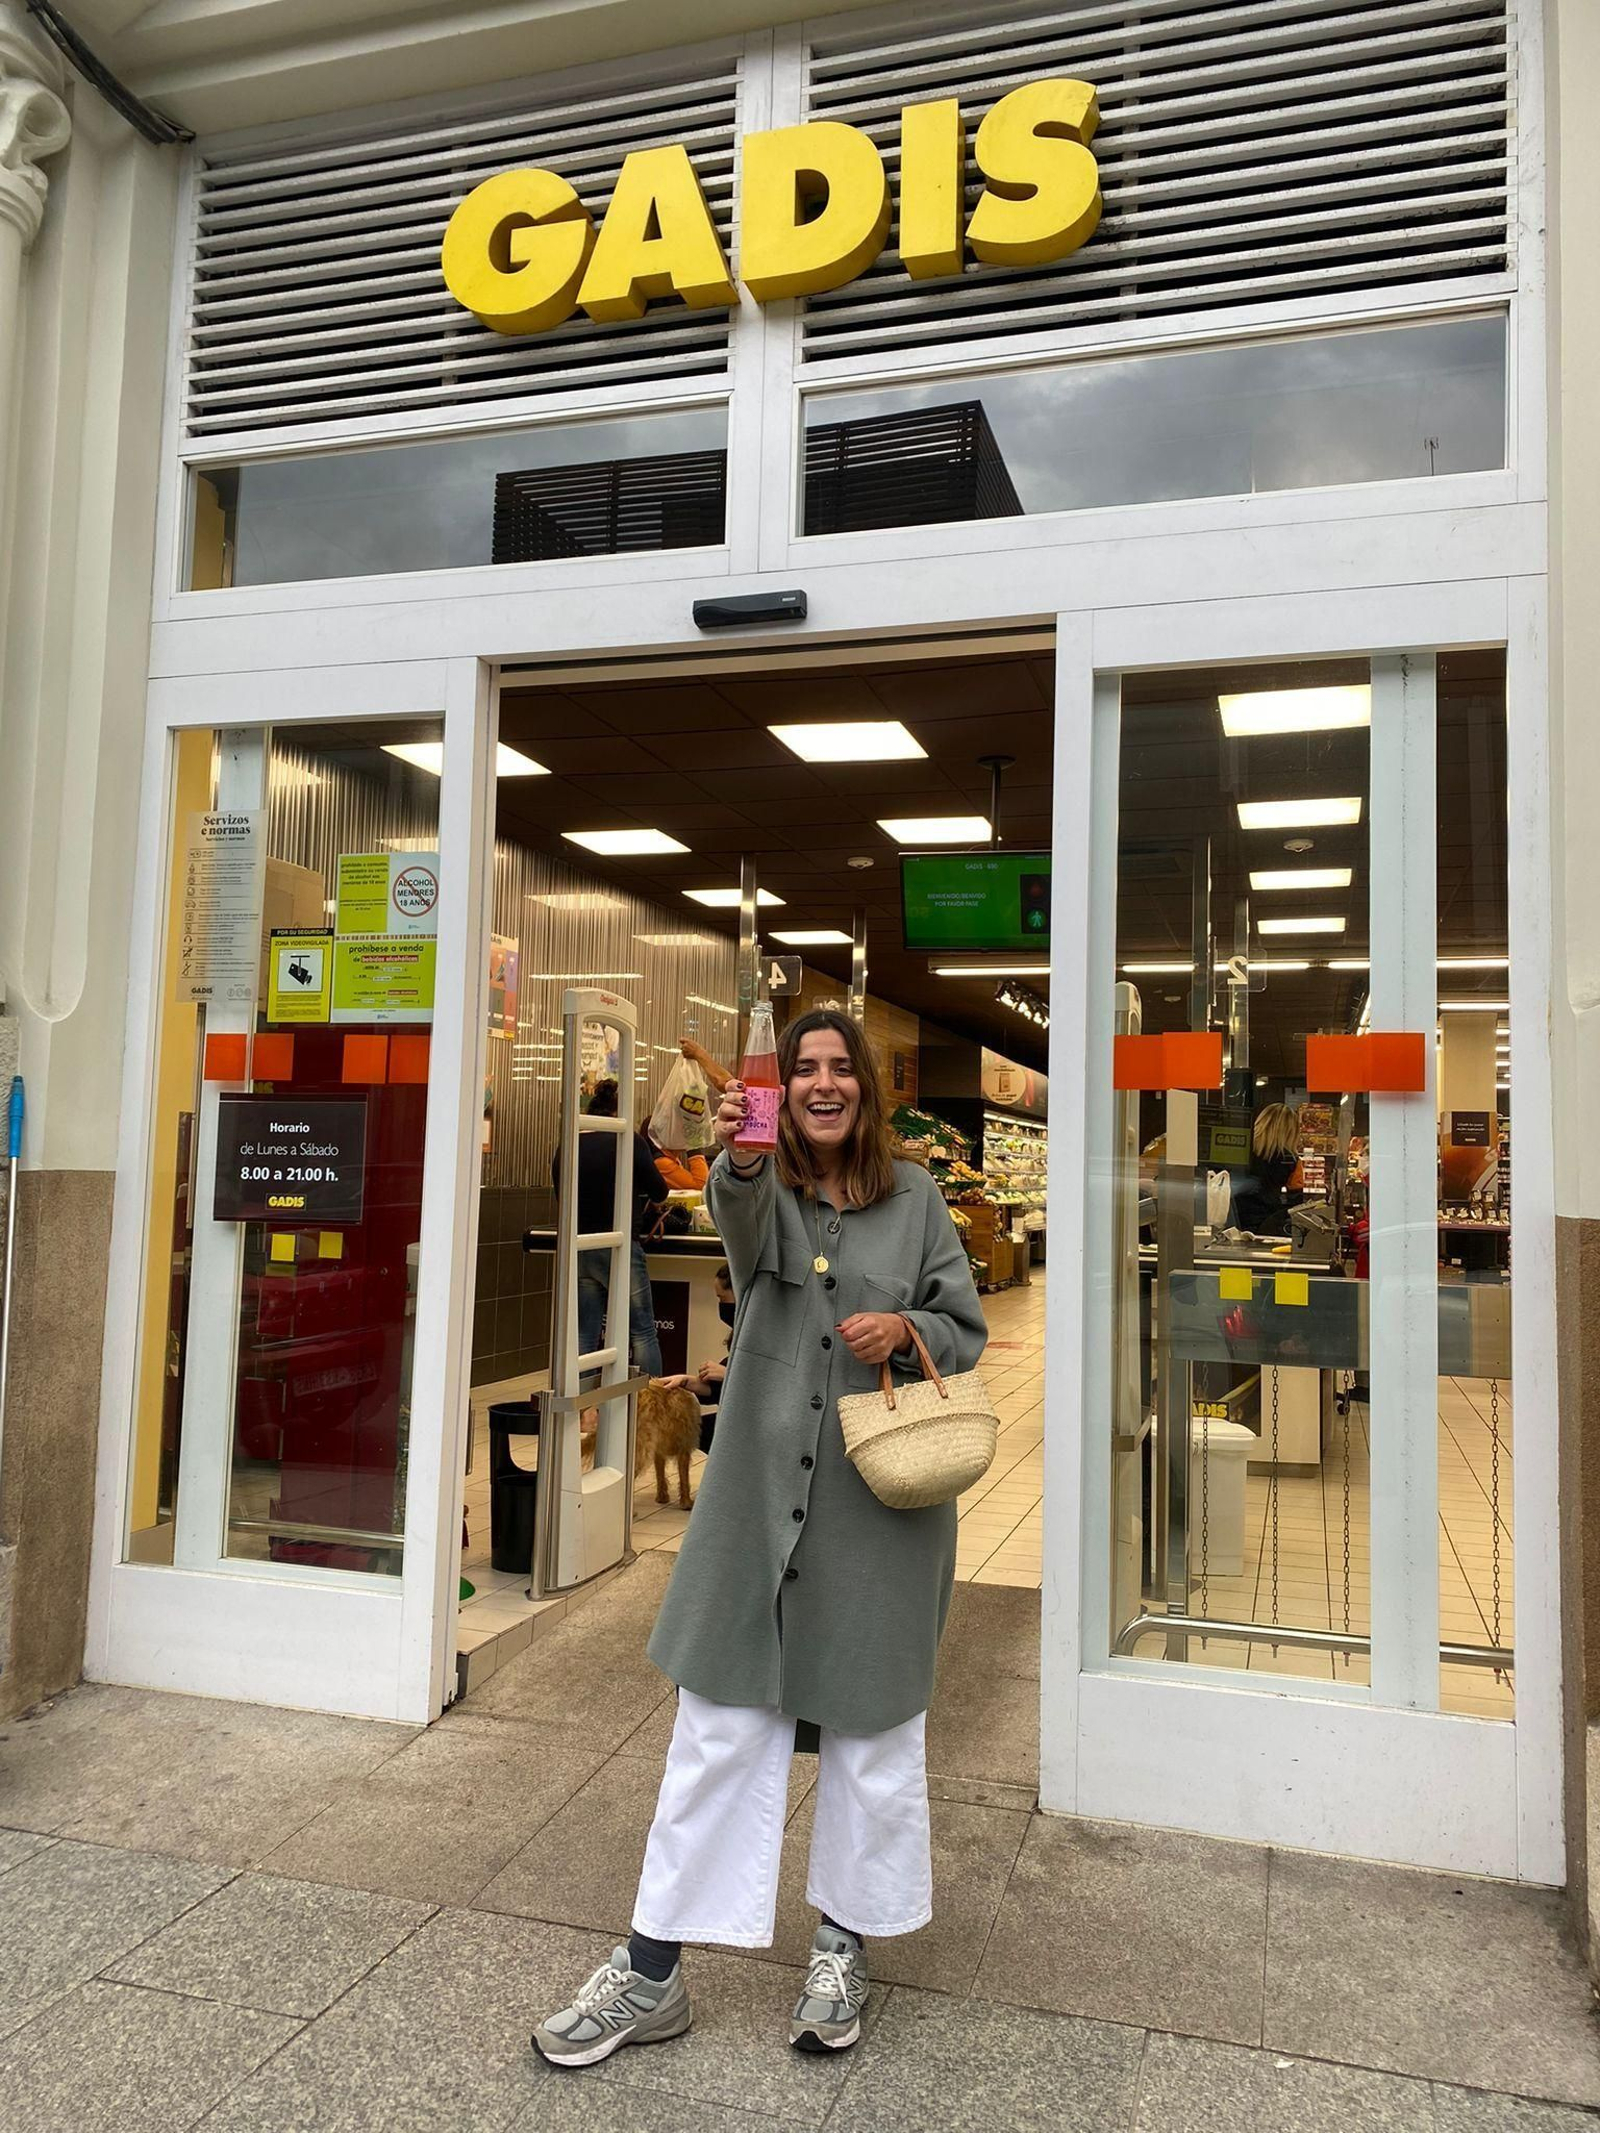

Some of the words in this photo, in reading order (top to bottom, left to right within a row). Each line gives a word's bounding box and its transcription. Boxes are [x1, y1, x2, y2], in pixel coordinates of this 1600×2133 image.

[441, 77, 1104, 335] GADIS
[203, 813, 250, 826] Servizos
[201, 827, 208, 836] e
[209, 826, 251, 835] normas
[398, 878, 434, 887] ALCOHOL
[397, 889, 435, 897] MENORES
[400, 899, 408, 907] 18
[399, 944, 424, 952] venda
[269, 1122, 310, 1133] Horario
[1216, 1134, 1246, 1146] GADIS
[240, 1142, 254, 1155] de
[257, 1142, 288, 1156] Lunes
[290, 1146, 297, 1156] a
[300, 1142, 339, 1157] Sábado
[240, 1166, 270, 1180] 8.00
[273, 1170, 283, 1180] a
[286, 1167, 322, 1181] 21.00
[325, 1167, 339, 1181] h.
[268, 1196, 304, 1207] GADIS
[598, 1999, 636, 2031] N
